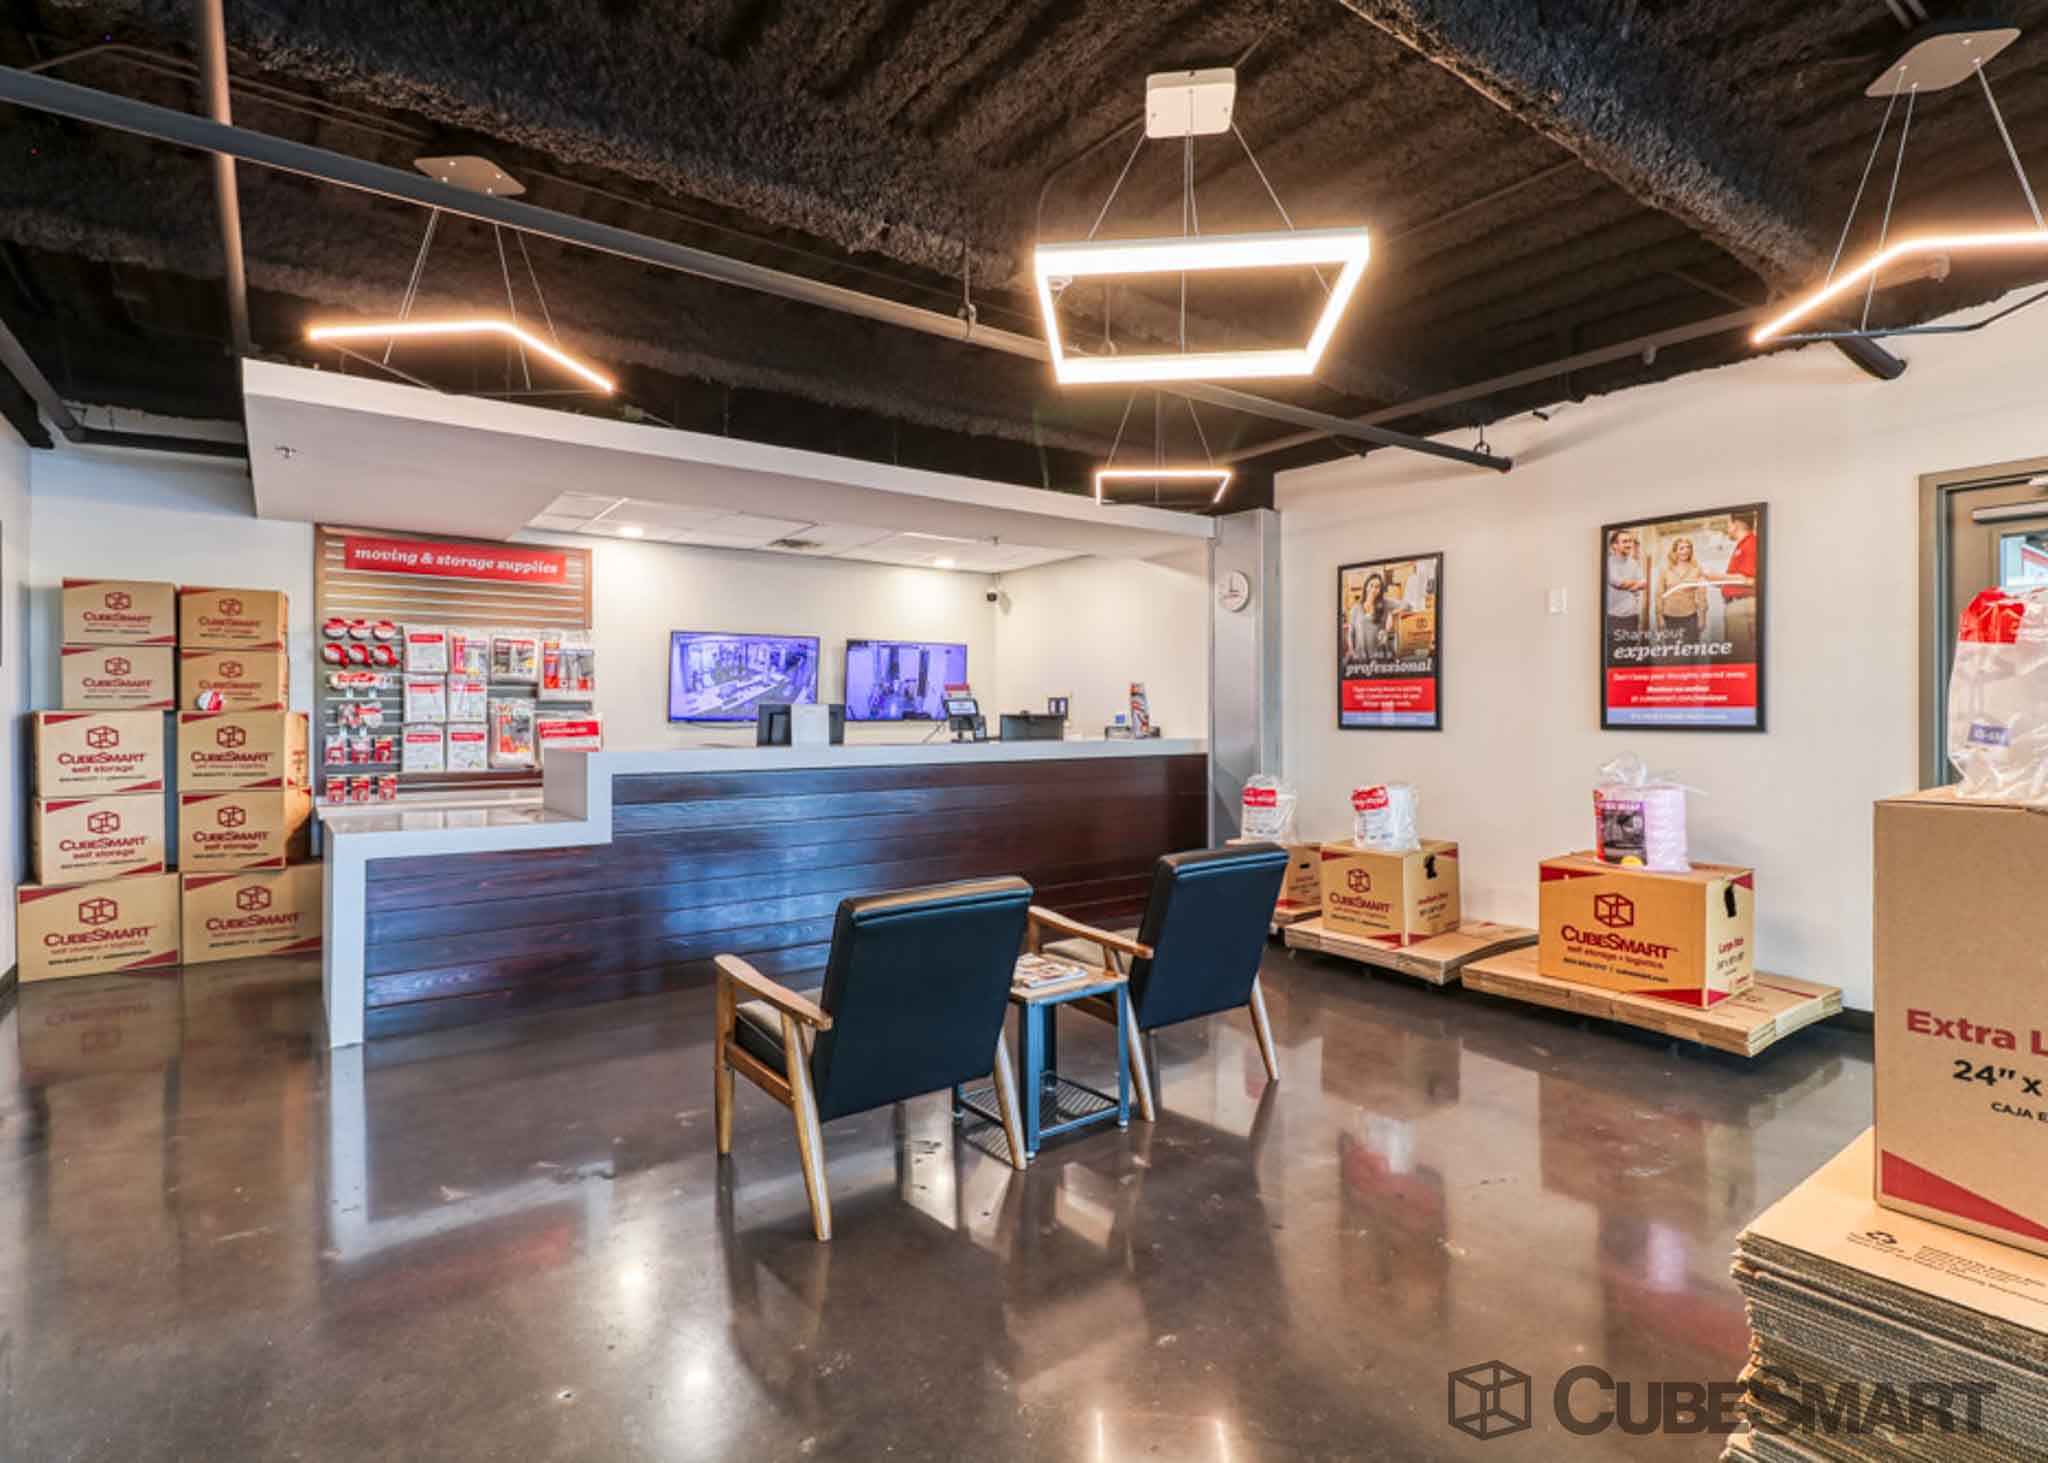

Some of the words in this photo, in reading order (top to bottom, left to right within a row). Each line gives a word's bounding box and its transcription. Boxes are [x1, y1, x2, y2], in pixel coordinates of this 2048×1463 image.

[354, 548, 417, 566] moving
[420, 552, 434, 564] &
[436, 554, 494, 571] storage
[497, 559, 559, 576] supplies
[1614, 641, 1733, 662] experience
[1345, 658, 1432, 677] professional
[1907, 1008, 2016, 1050] Extra
[1952, 1059, 2016, 1087] 24"
[2021, 1076, 2042, 1097] x
[1991, 1102, 2033, 1120] CAJA
